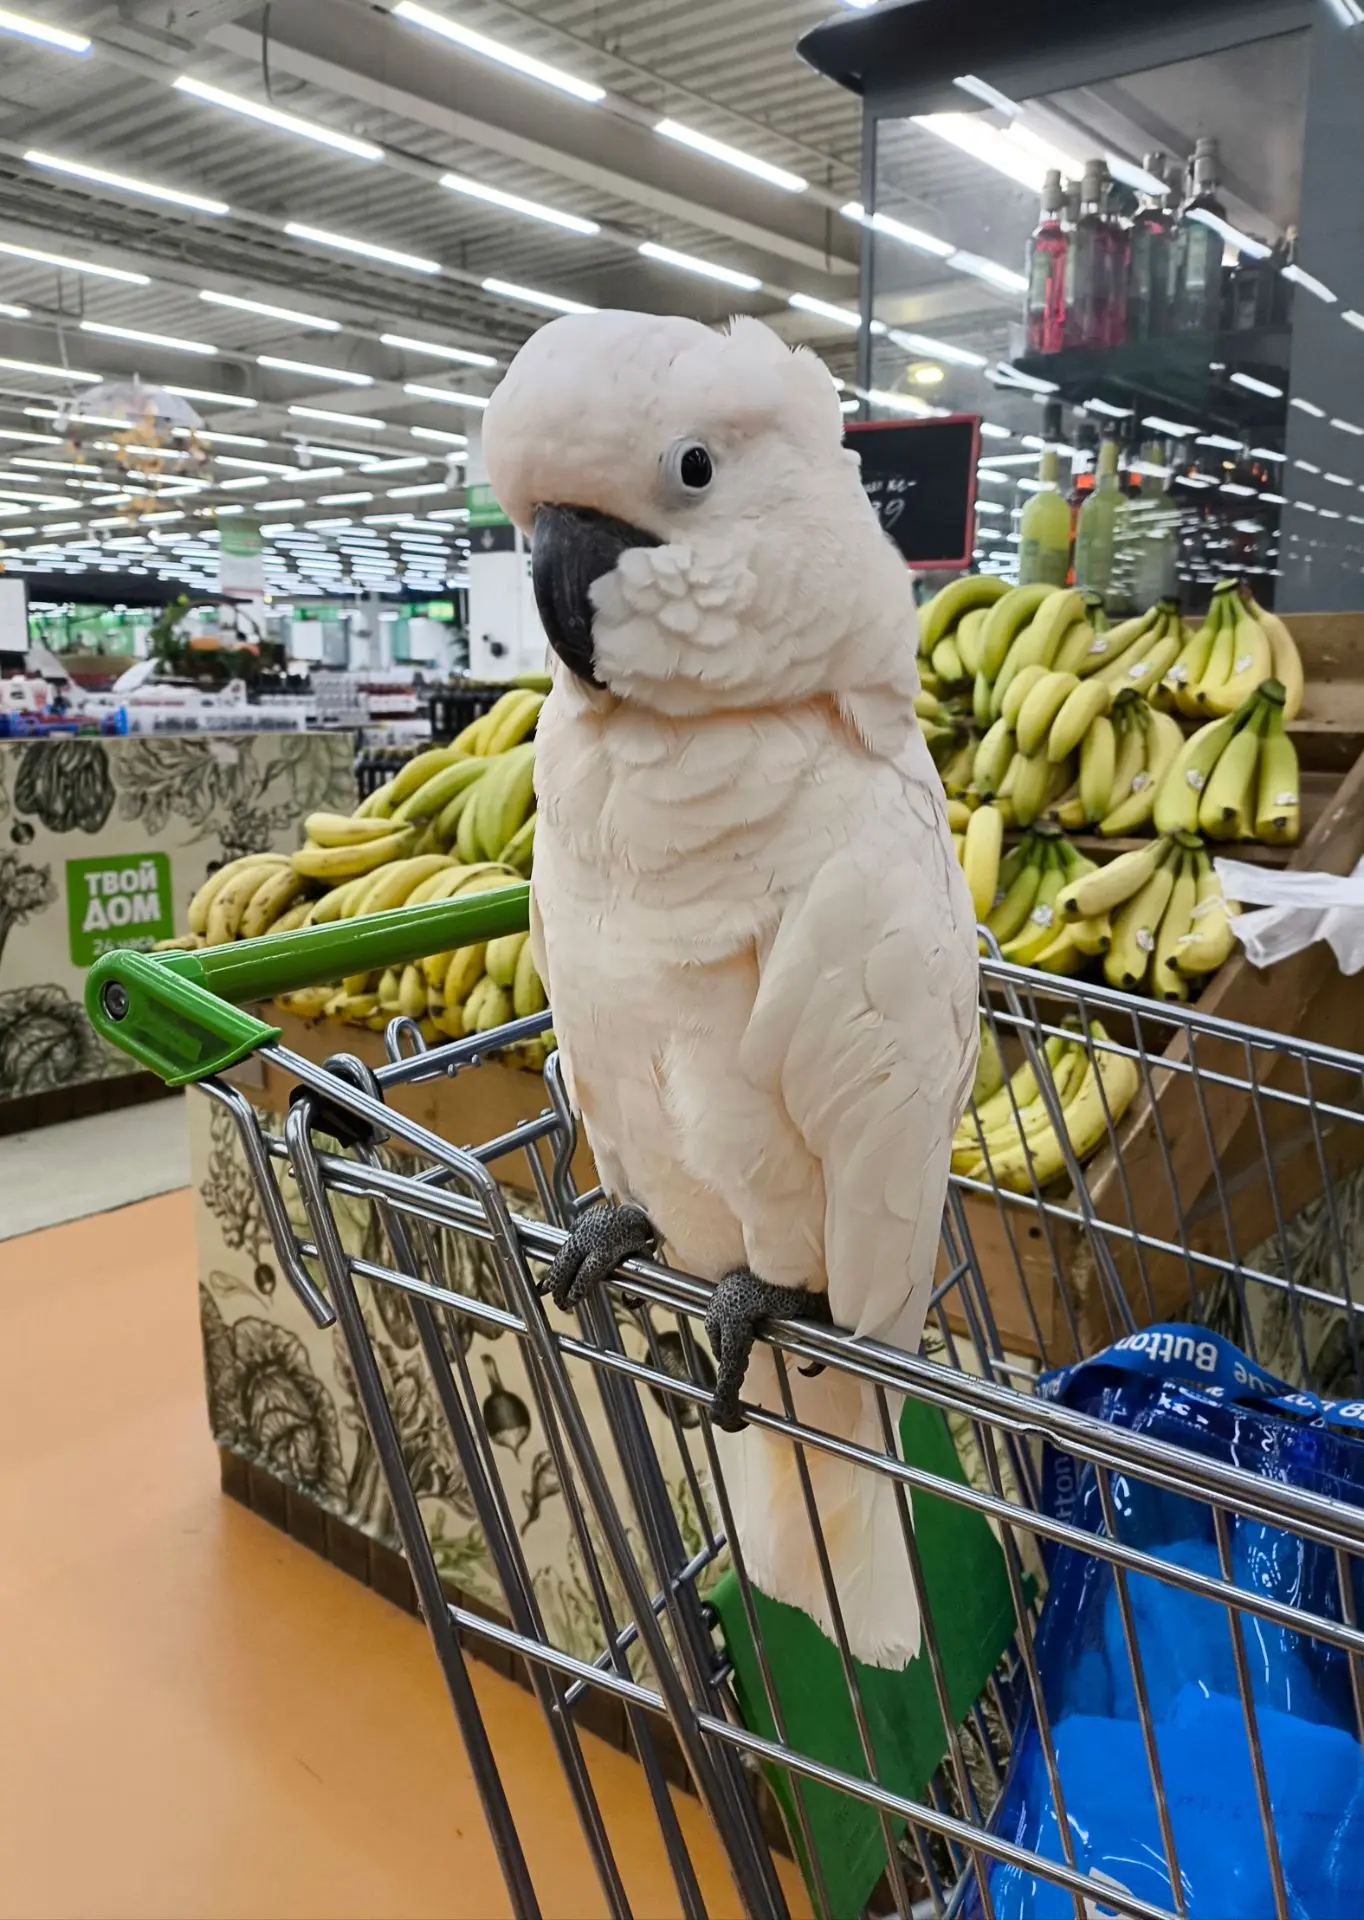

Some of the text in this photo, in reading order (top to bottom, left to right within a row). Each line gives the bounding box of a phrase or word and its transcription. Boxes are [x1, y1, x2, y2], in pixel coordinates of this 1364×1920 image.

[83, 859, 157, 896] ТВОЙ
[82, 892, 161, 933] ДОМ
[1114, 1332, 1218, 1373] Button
